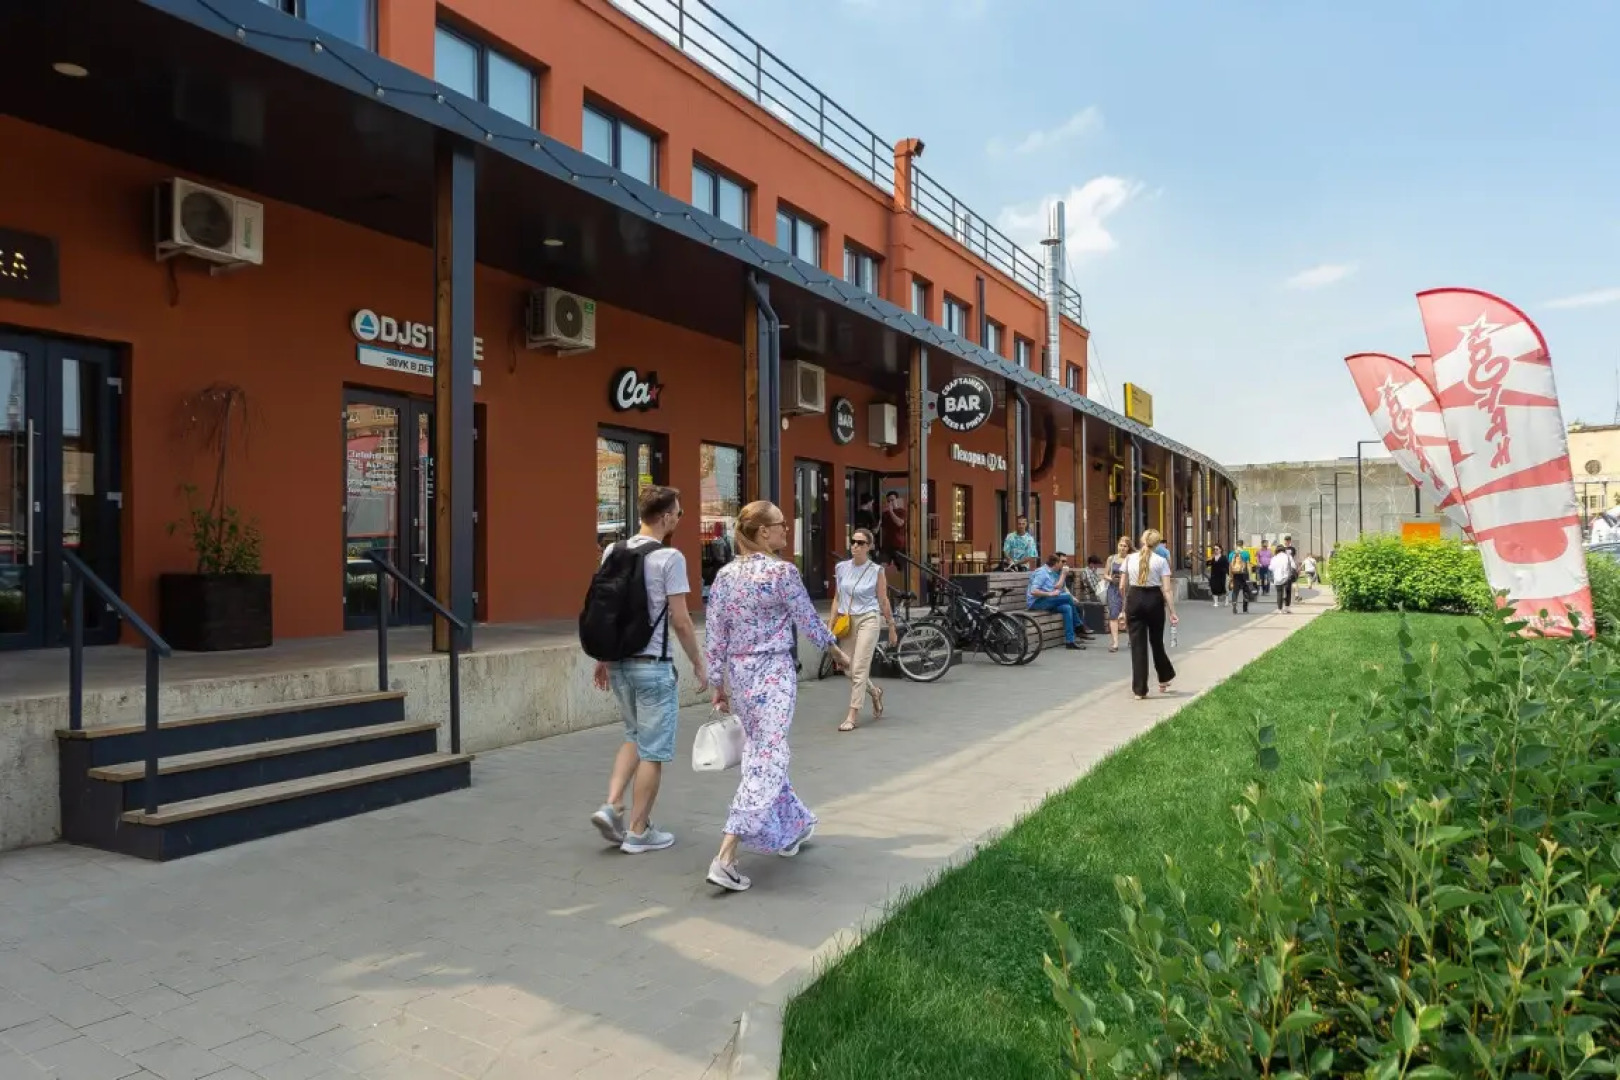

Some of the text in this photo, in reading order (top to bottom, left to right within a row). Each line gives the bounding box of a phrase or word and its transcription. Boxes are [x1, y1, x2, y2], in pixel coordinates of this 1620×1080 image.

[386, 356, 409, 369] ЗВУК
[944, 394, 981, 413] BAR
[838, 411, 853, 429] BAR
